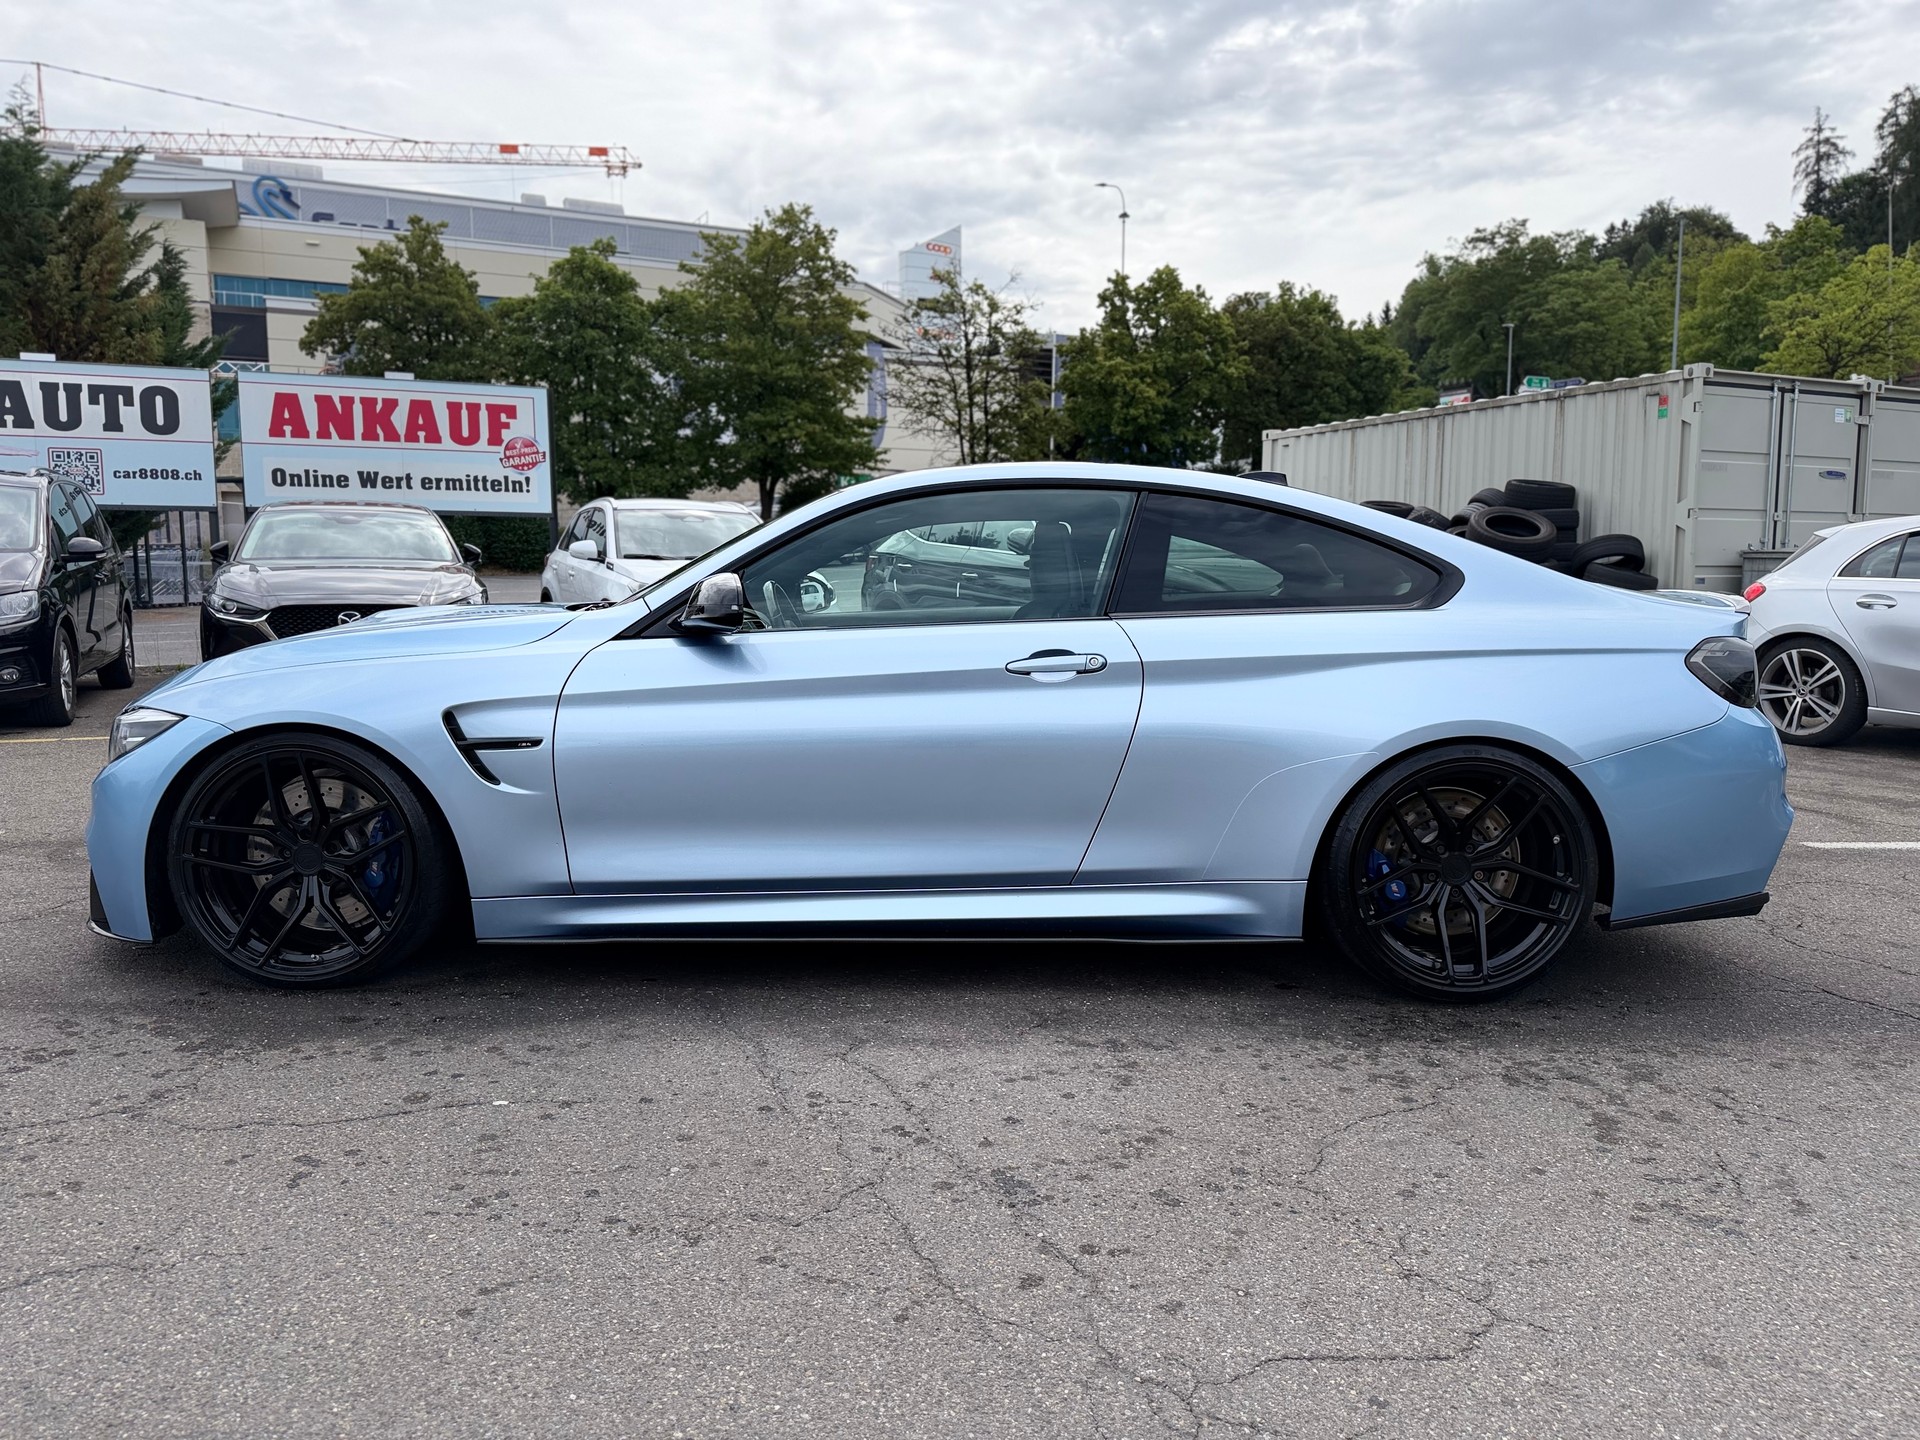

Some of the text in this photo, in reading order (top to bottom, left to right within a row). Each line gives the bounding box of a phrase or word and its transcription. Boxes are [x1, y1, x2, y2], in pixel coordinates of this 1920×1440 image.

[926, 242, 952, 255] coop
[0, 379, 180, 436] AUTO
[268, 392, 518, 447] ANKAUF
[502, 453, 545, 467] GARANTIE
[113, 468, 202, 481] car8808.ch
[271, 467, 531, 493] Online Wert ermitteln!
